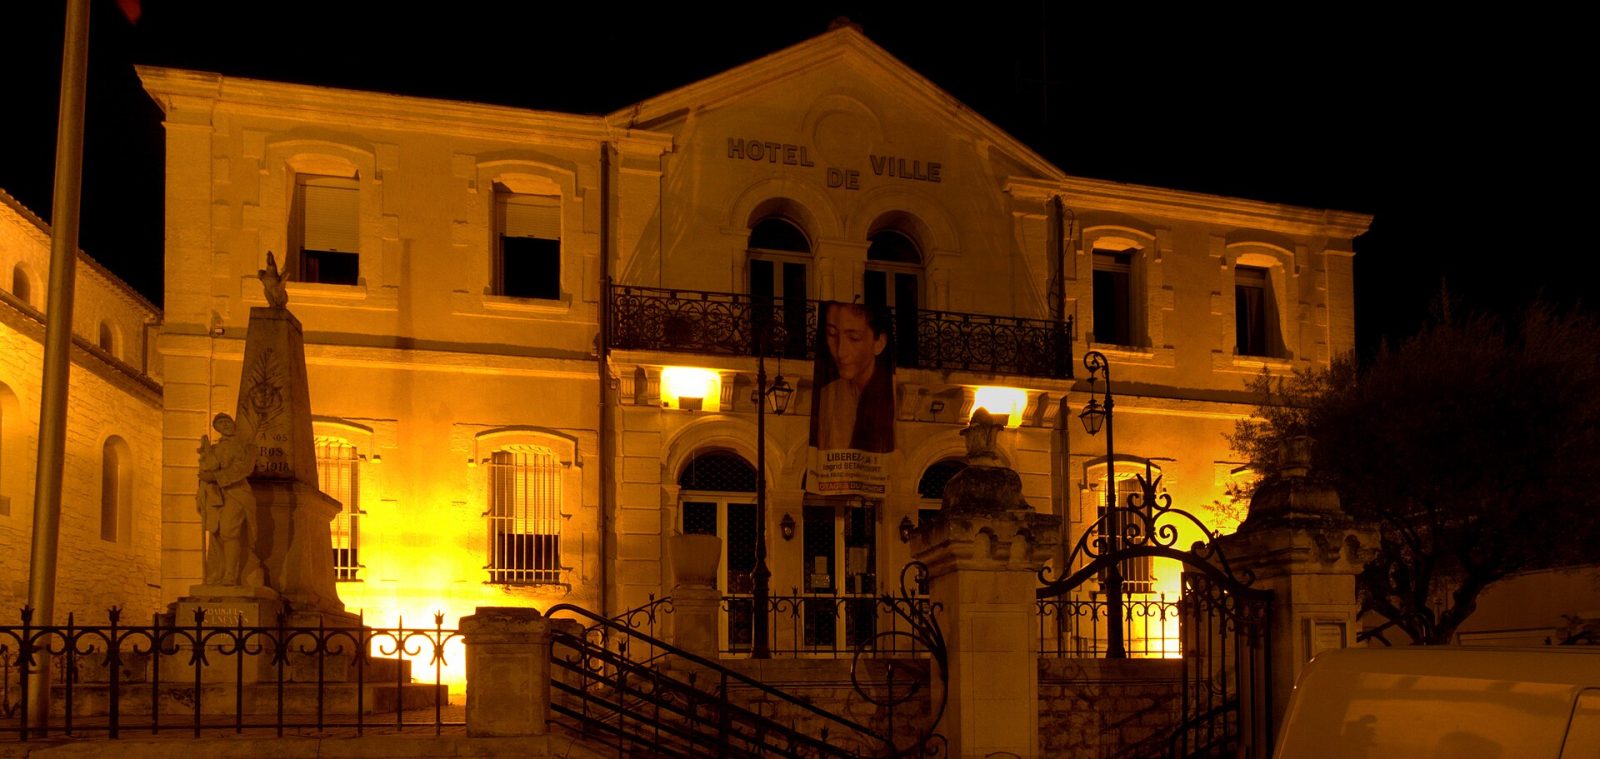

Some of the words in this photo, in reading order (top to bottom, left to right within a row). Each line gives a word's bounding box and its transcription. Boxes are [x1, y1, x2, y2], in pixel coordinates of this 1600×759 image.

[727, 137, 815, 168] HOTEL
[826, 167, 861, 191] DE
[869, 154, 942, 184] VILLE
